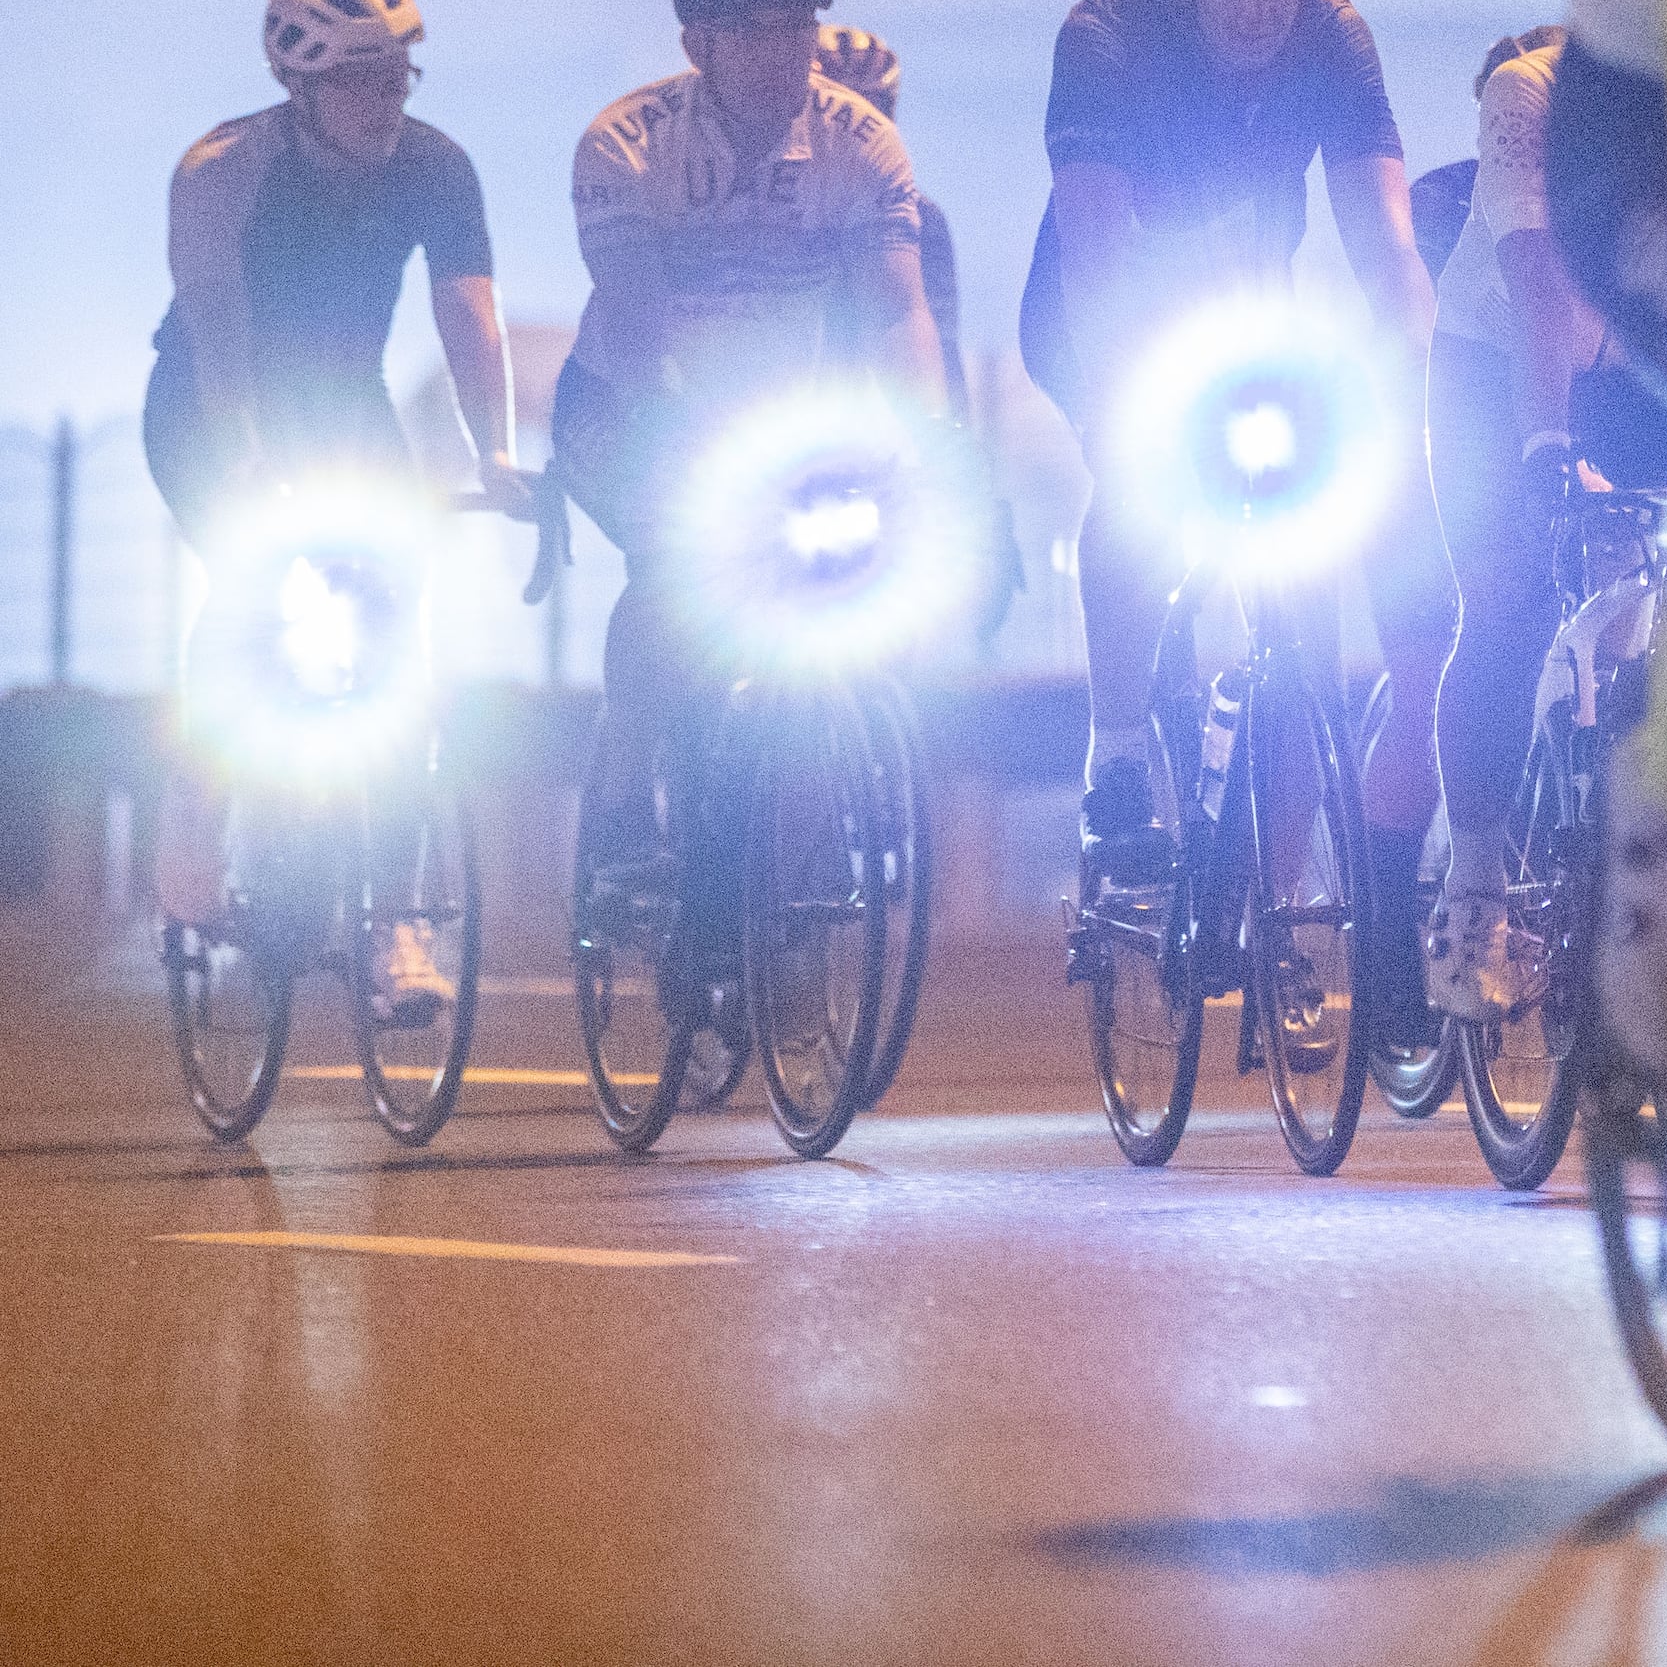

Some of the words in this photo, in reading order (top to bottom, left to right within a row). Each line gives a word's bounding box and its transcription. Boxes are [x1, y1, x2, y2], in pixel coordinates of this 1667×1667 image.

[612, 91, 683, 143] UAE
[812, 90, 883, 143] UAE
[685, 160, 802, 209] UAE
